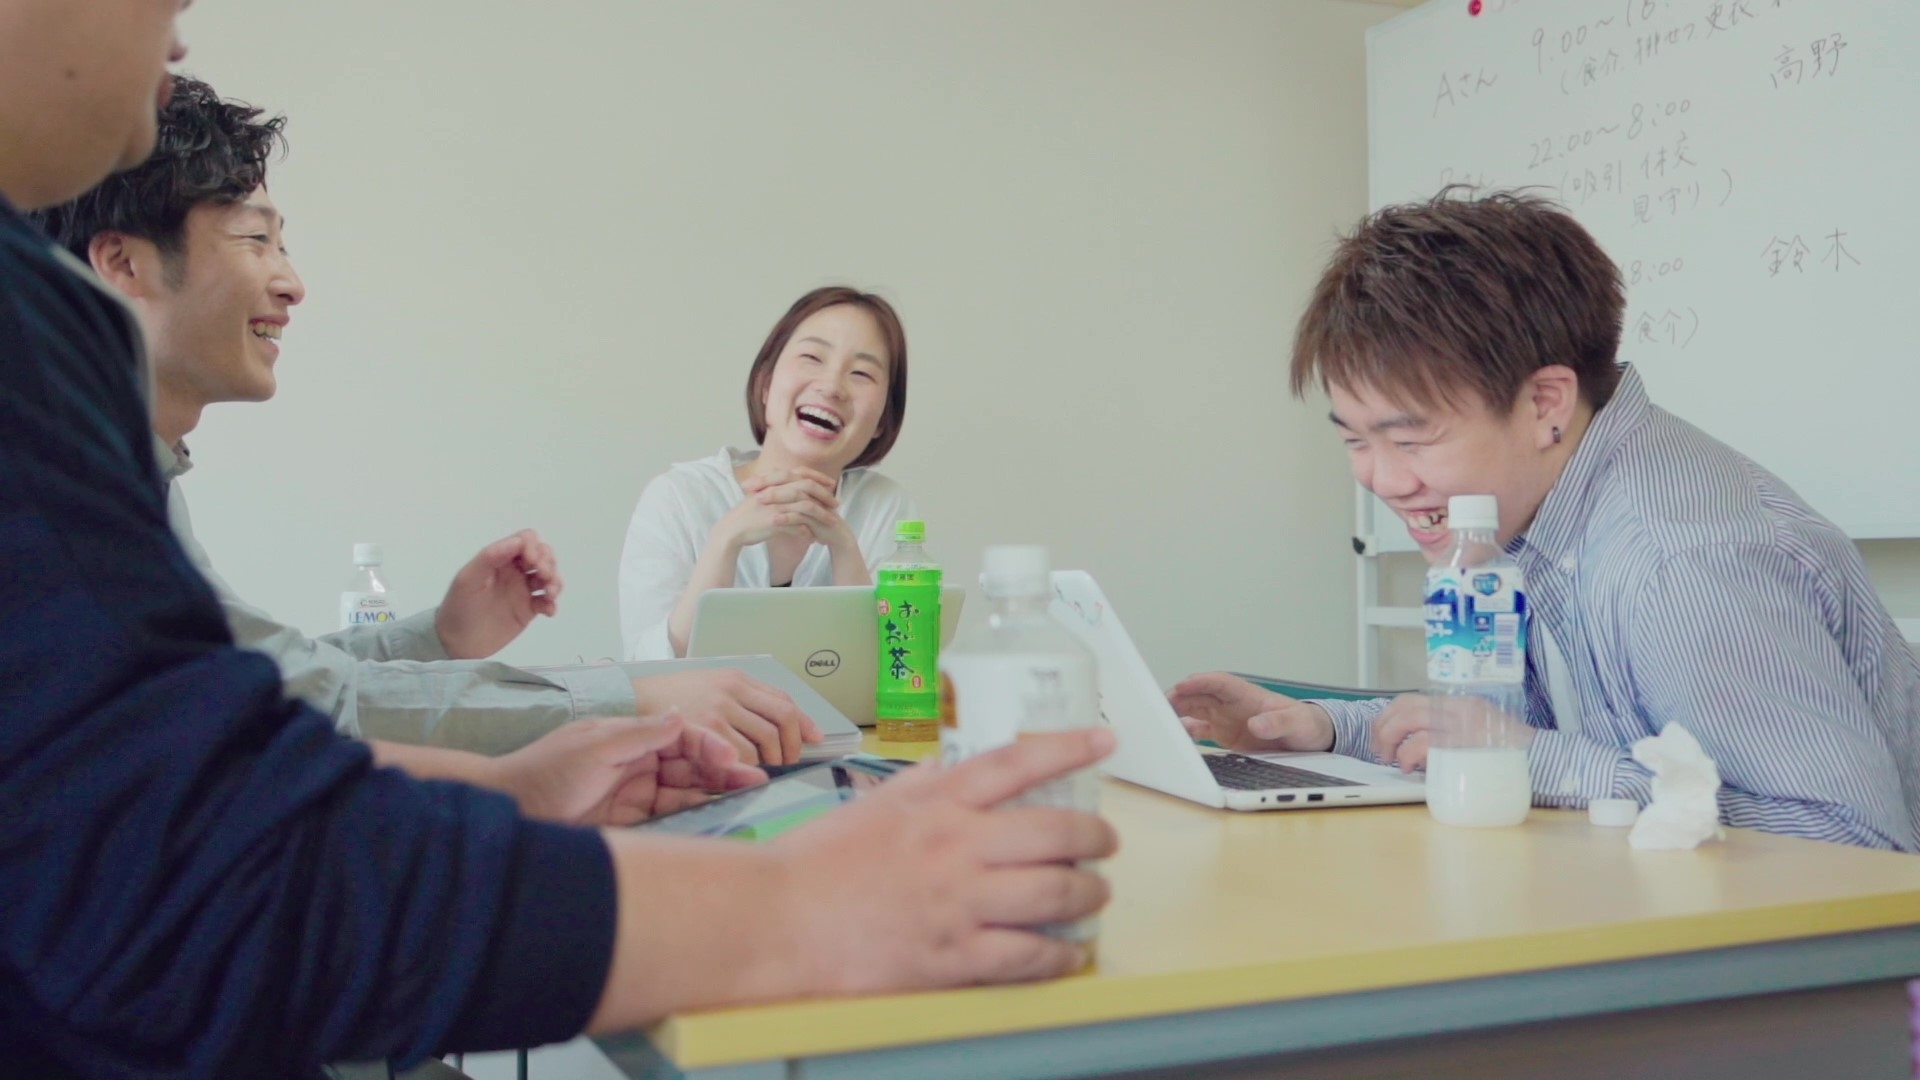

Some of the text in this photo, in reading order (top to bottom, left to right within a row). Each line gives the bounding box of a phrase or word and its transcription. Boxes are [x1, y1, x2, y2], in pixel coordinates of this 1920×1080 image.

[1769, 32, 1848, 90] 高野
[1433, 66, 1499, 118] Aさん
[1760, 226, 1862, 279] 鈴木
[348, 610, 397, 625] LEMON
[884, 617, 915, 680] お茶
